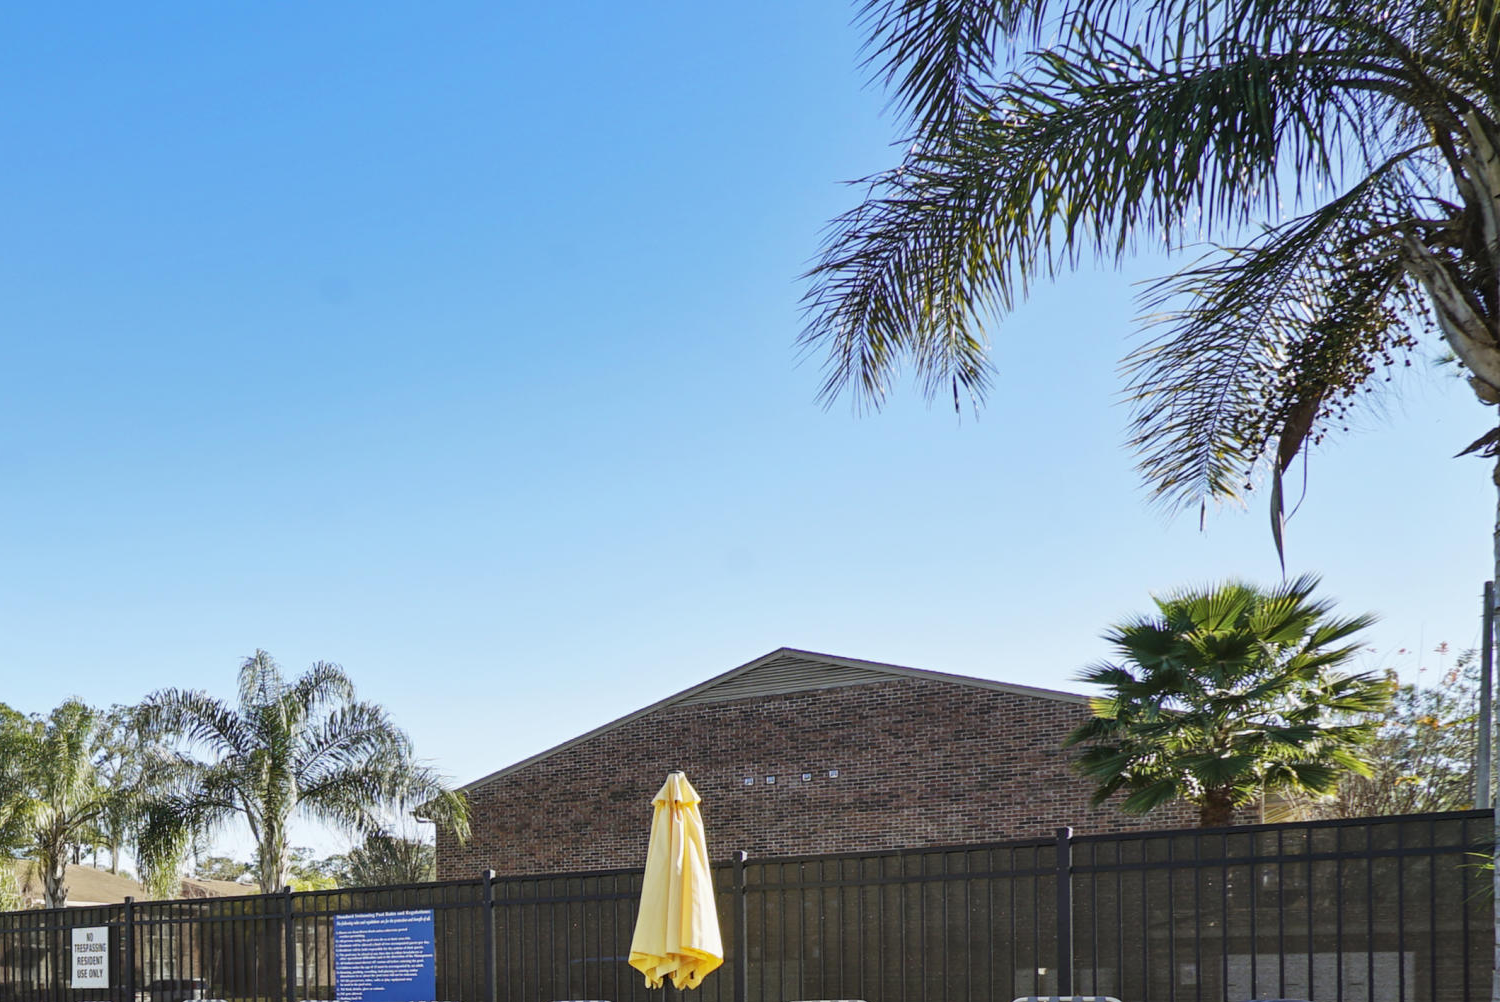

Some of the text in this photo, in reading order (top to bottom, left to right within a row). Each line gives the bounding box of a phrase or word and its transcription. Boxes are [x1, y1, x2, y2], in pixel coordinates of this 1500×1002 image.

[86, 933, 93, 942] NO
[74, 943, 106, 952] TRESPASSING
[77, 956, 103, 965] RESIDENT
[77, 969, 103, 978] USE ONLY
